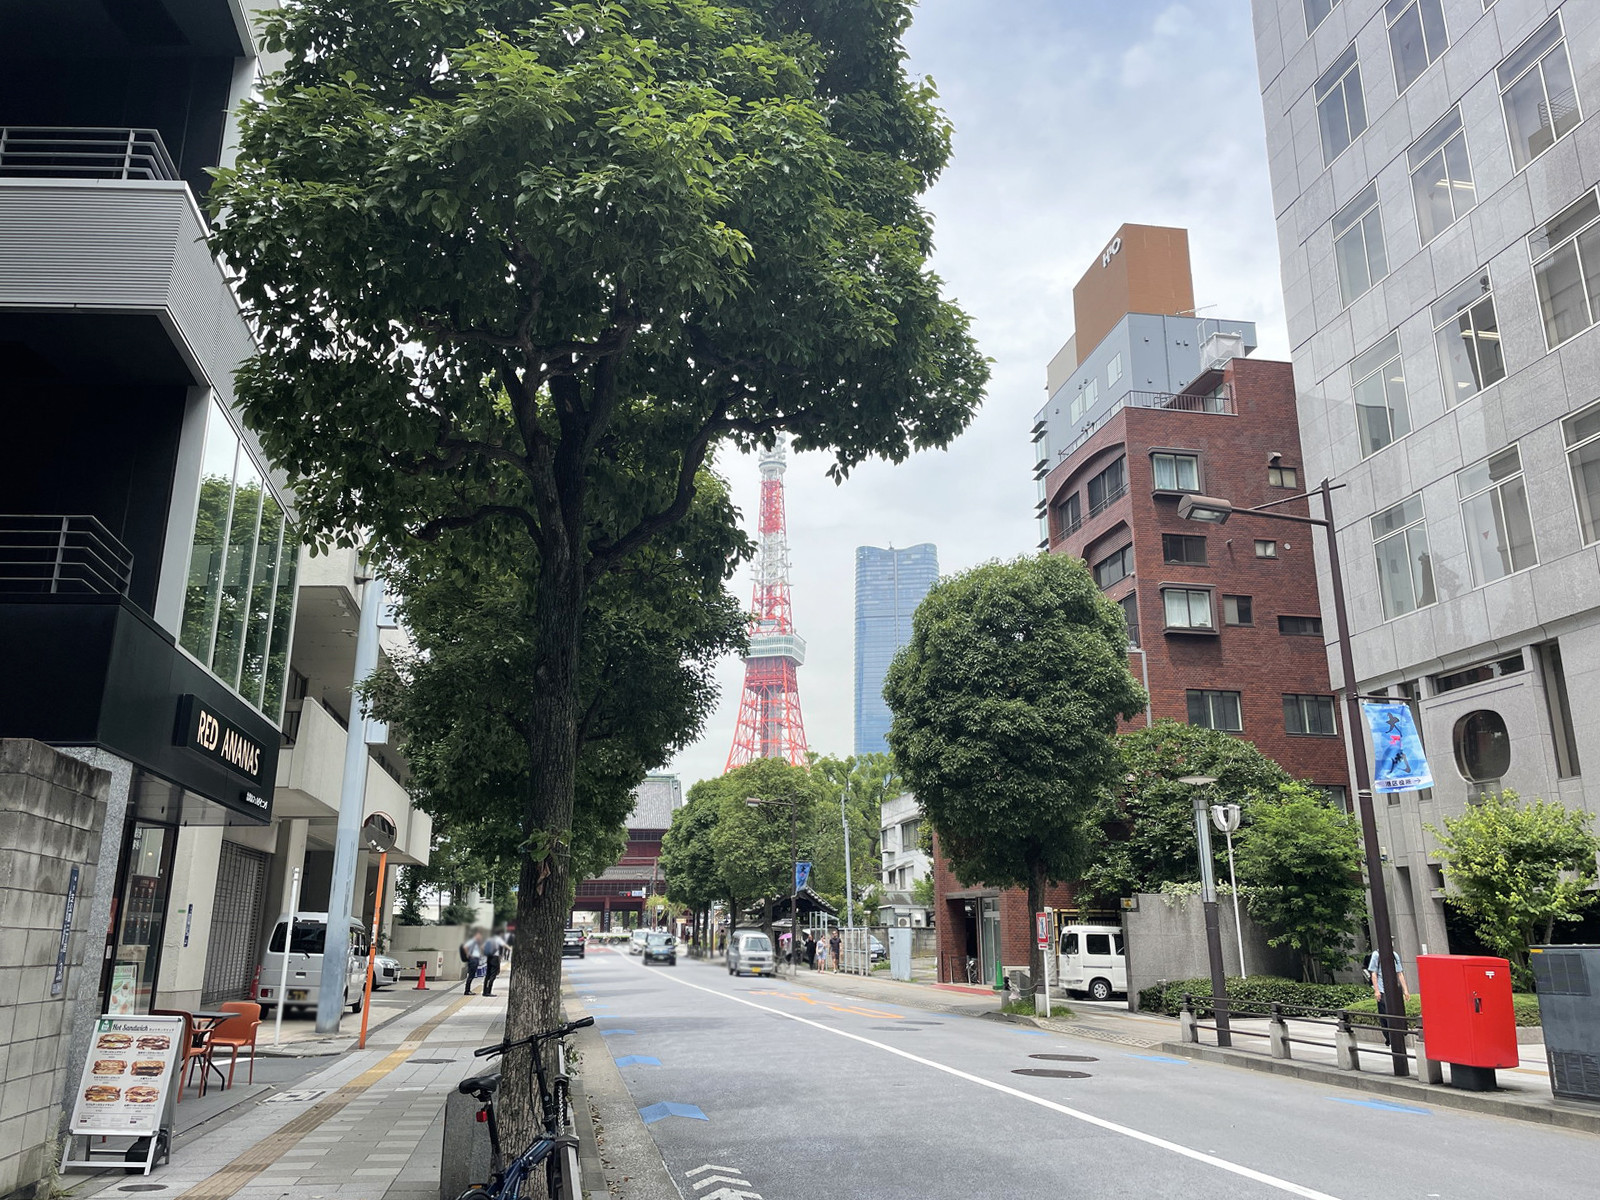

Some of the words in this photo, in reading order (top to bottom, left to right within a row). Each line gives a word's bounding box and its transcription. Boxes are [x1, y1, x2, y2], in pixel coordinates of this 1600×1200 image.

[197, 710, 219, 751] RED
[221, 728, 260, 776] ANANAS
[1385, 779, 1412, 787] 港区役所
